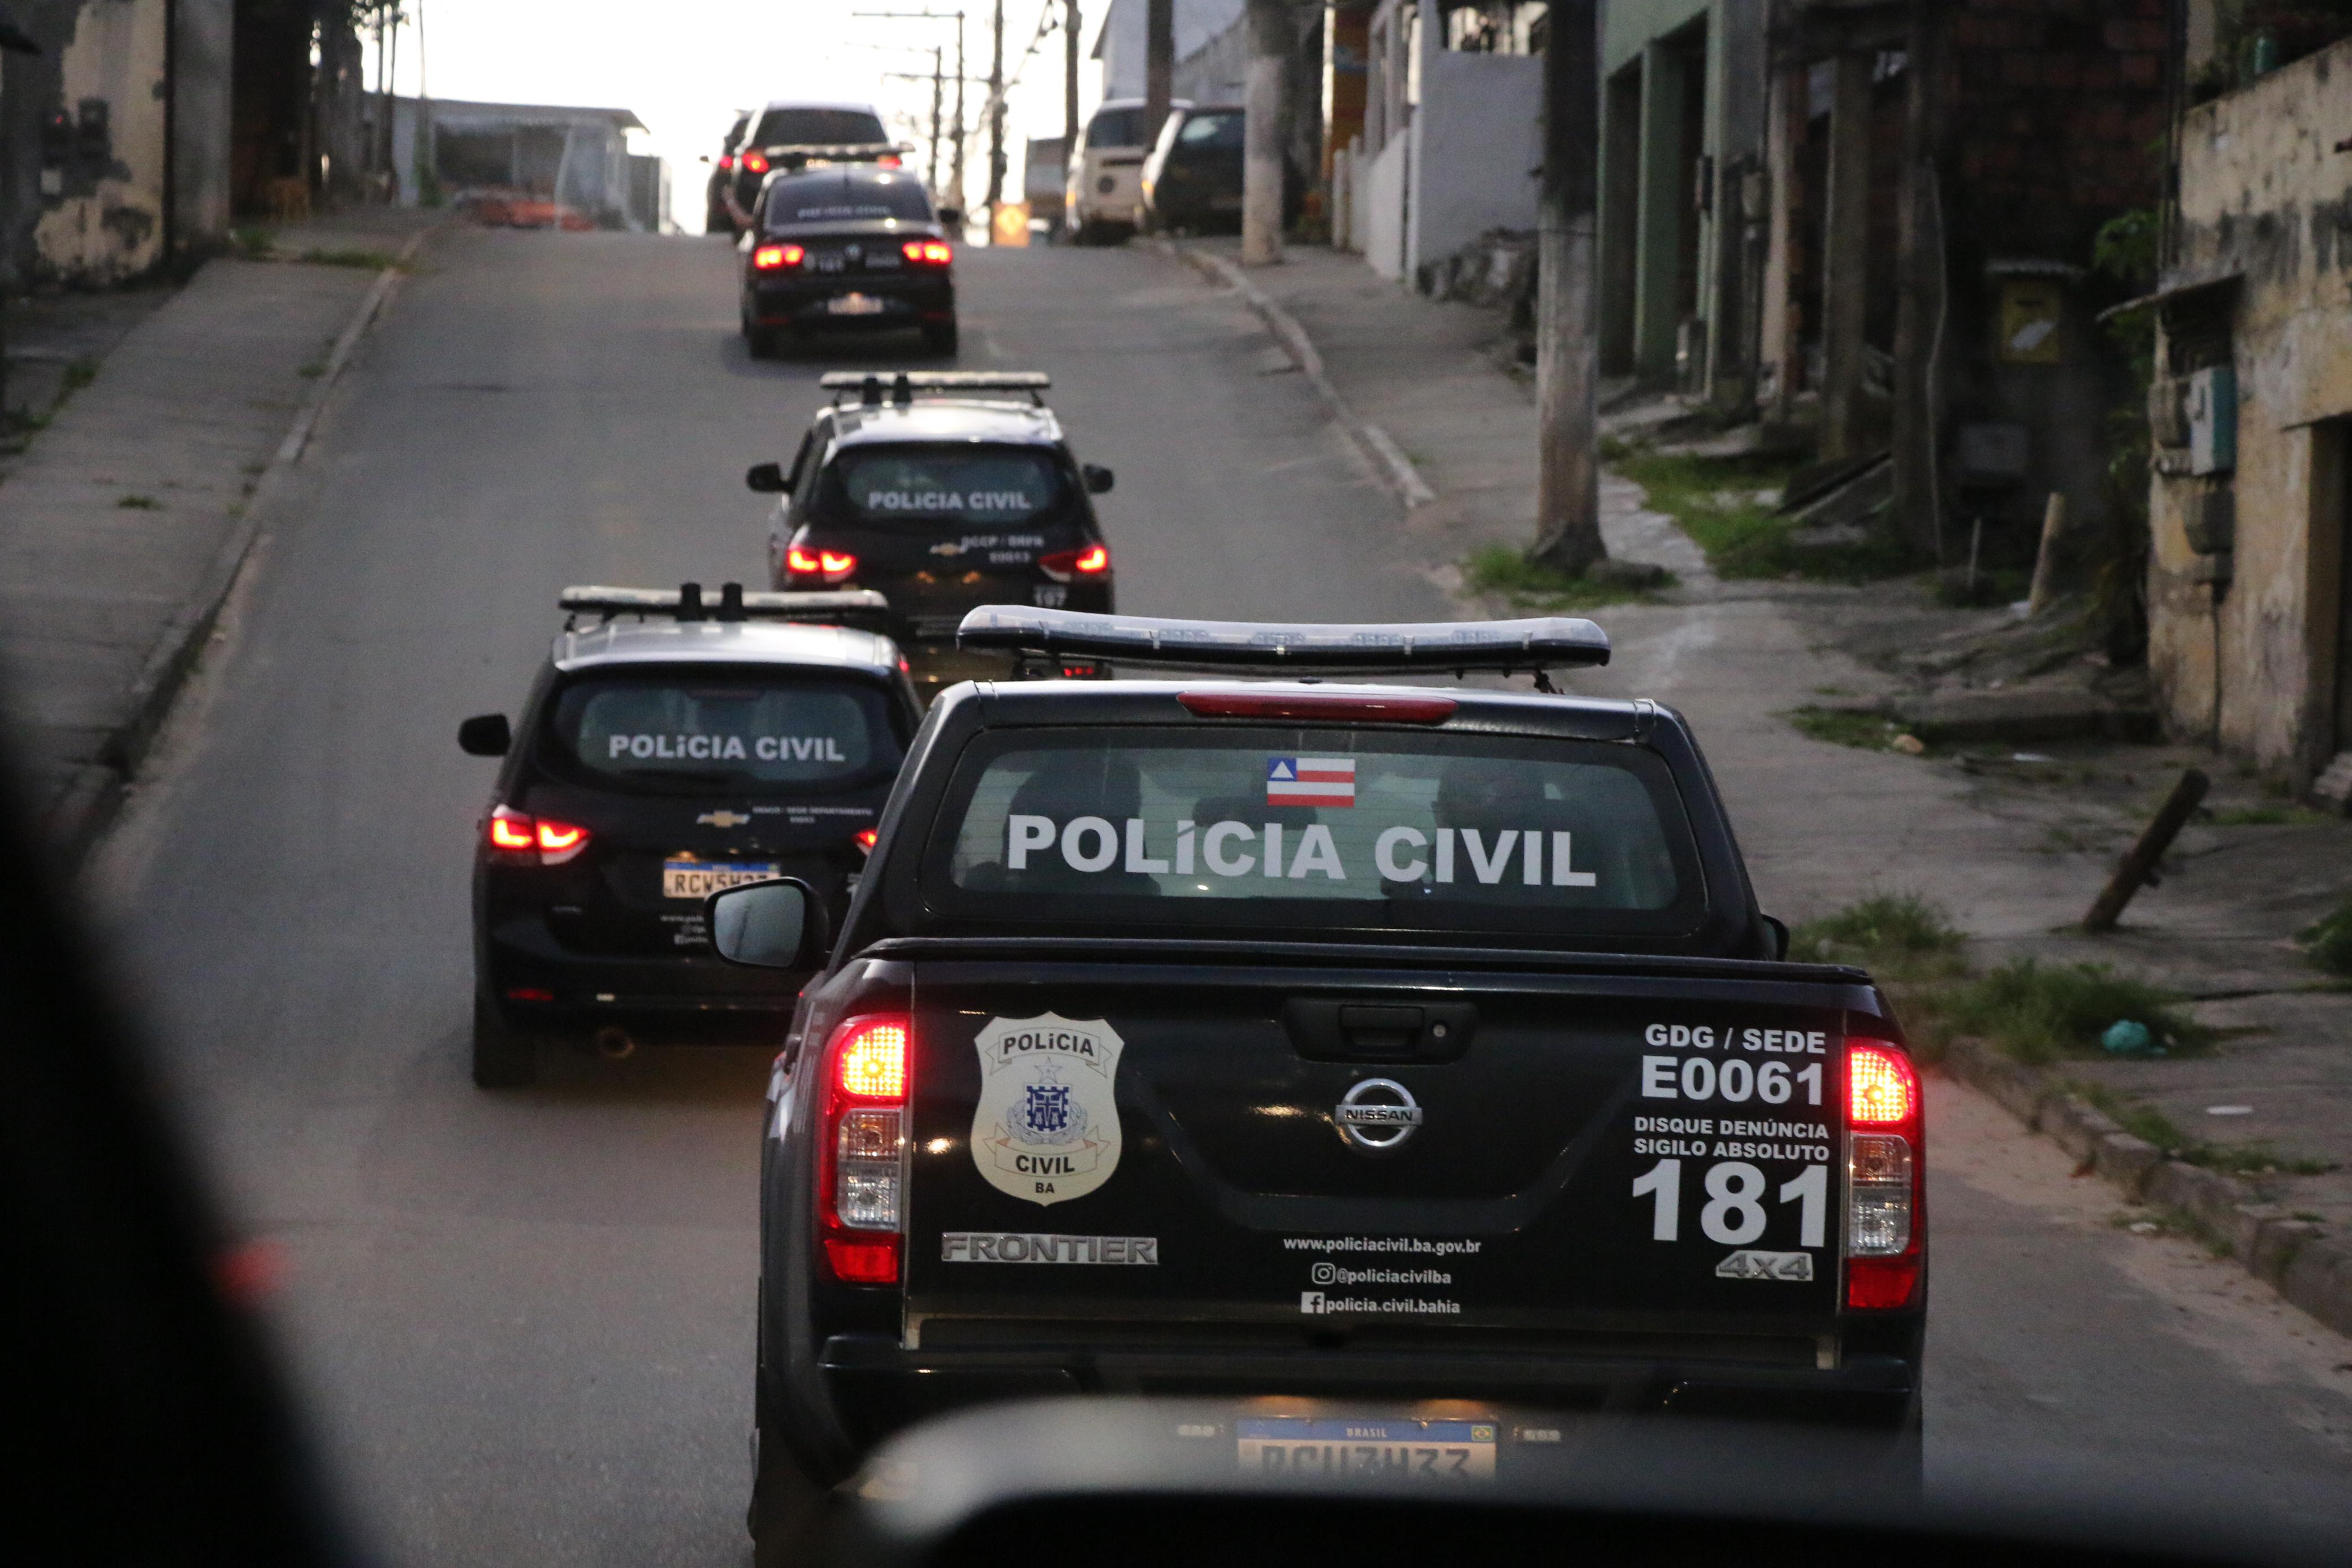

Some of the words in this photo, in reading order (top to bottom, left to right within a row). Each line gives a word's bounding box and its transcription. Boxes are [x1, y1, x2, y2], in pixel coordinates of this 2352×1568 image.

[969, 492, 1031, 509] CIVIL
[755, 737, 846, 761] CIVIL
[1375, 825, 1596, 887] CIVIL
[1645, 1024, 1714, 1048] GDG
[1724, 1028, 1733, 1050] /
[1743, 1028, 1826, 1054] SEDE
[1642, 1055, 1822, 1105] E0061
[1346, 1108, 1412, 1121] NISSAN
[1635, 1116, 1713, 1134] DISQUE
[1720, 1119, 1829, 1139] DENÚNCIA
[1634, 1138, 1707, 1155] SIGILO
[1712, 1141, 1830, 1161] ABSOLUTO
[1015, 1154, 1075, 1175] CIVIL
[1035, 1182, 1055, 1194] BA
[1633, 1159, 1827, 1247] 181
[942, 1232, 1158, 1264] FRONTIER
[1283, 1237, 1481, 1256] www.policiacivil.ba.gov.br
[1337, 1268, 1452, 1285] @policiacivilba
[1326, 1298, 1460, 1314] policia.civil.bahia
[1347, 1428, 1387, 1438] BRASIL
